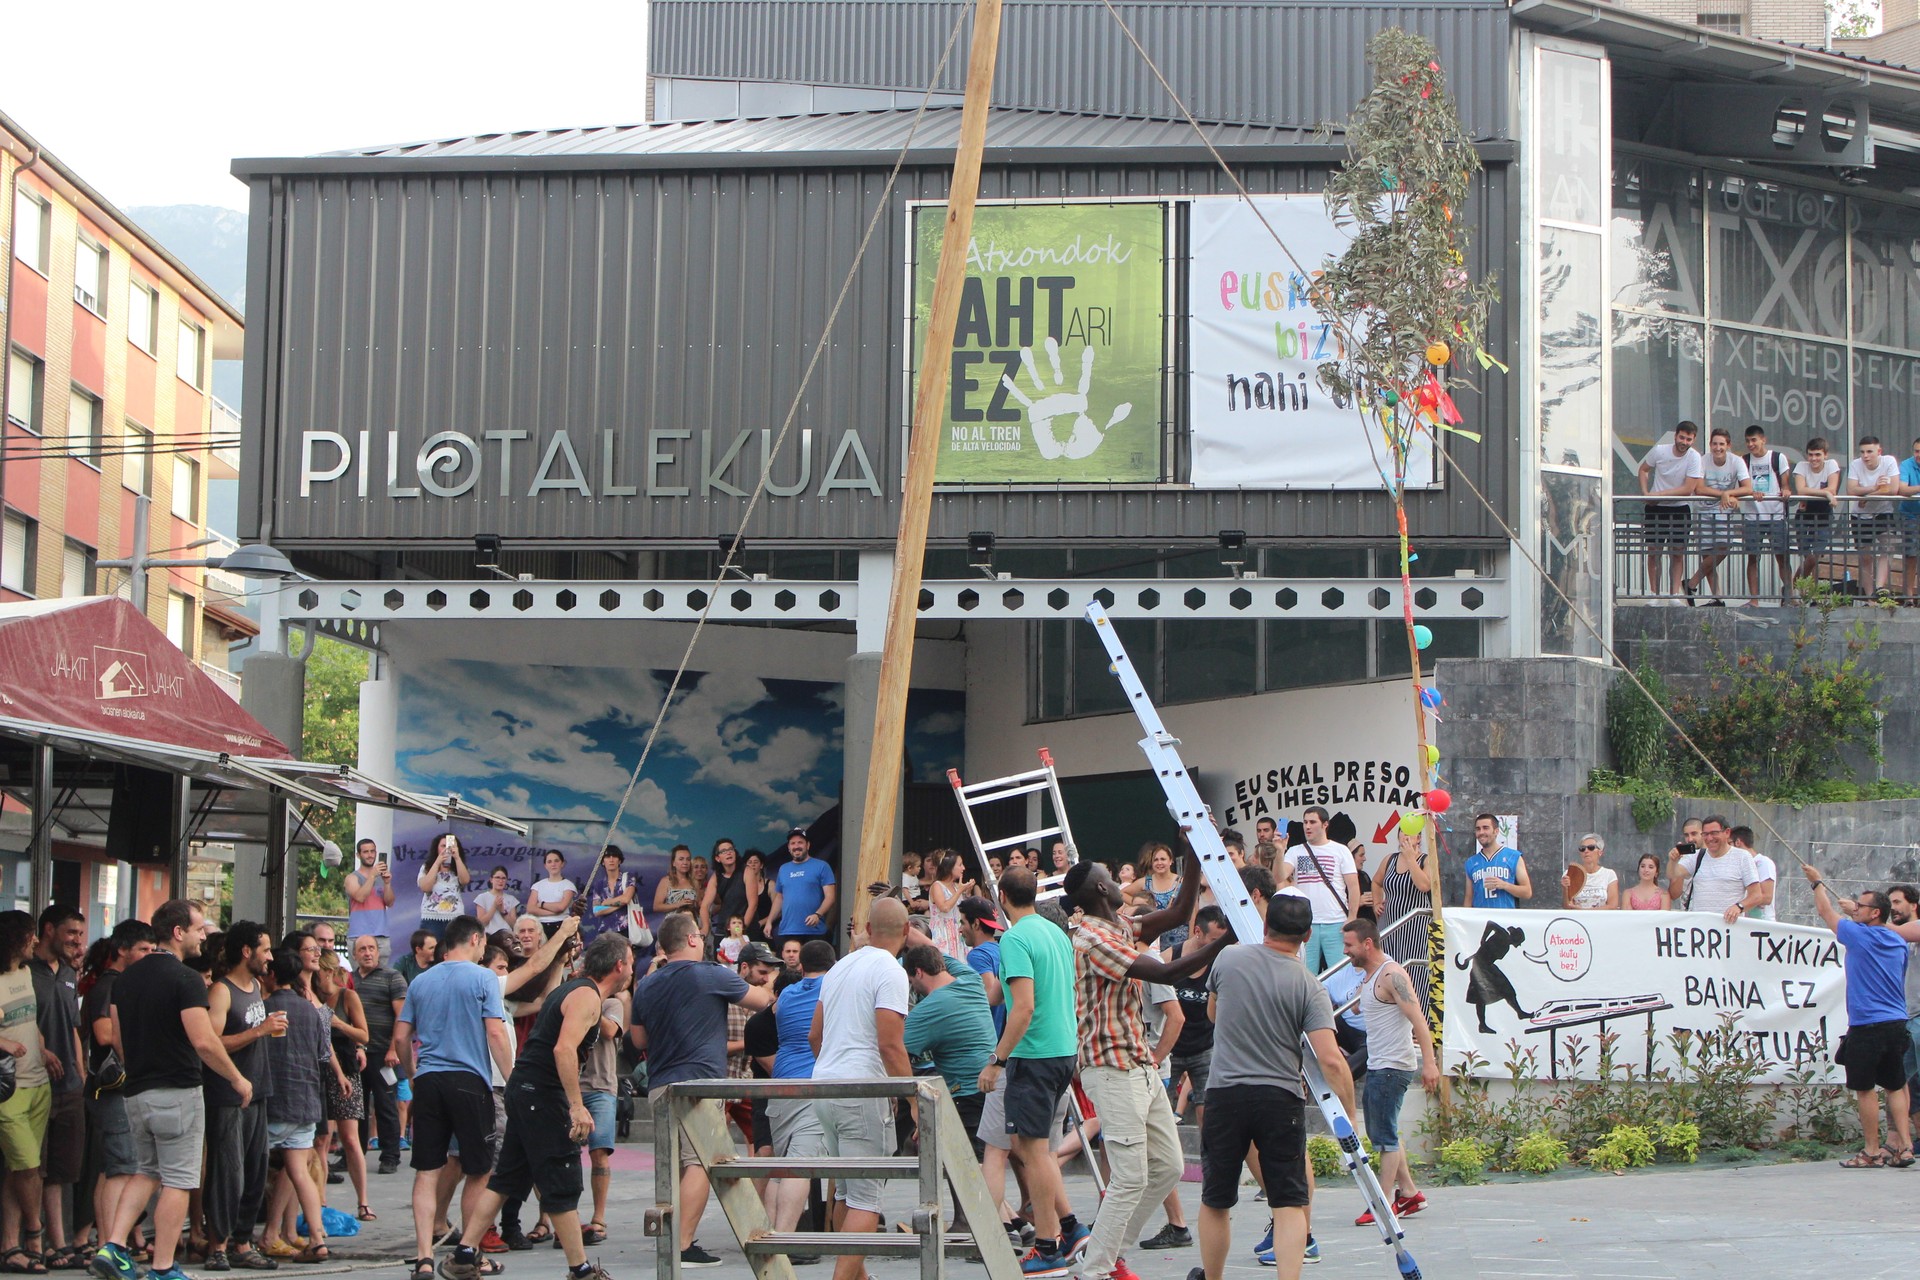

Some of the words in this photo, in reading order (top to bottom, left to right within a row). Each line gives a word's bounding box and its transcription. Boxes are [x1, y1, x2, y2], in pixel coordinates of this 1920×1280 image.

[951, 351, 1022, 422] EZ
[1226, 372, 1309, 412] nahi
[1711, 378, 1845, 431] ANBOTO
[952, 427, 968, 441] NO
[972, 427, 986, 441] AL
[990, 427, 1021, 441] TREN
[952, 442, 961, 451] DE
[963, 442, 979, 451] ALTA
[980, 442, 1021, 451] VELOCIDAD
[300, 429, 882, 499] PILOTALEKUA
[51, 651, 88, 681] JAI-KIT
[151, 672, 184, 699] JAI-KIT
[1235, 762, 1324, 803] EUSKAL
[1334, 761, 1410, 788] PRESO
[1225, 796, 1269, 827] ETA
[1277, 781, 1421, 810] IHESLARIAK
[1550, 934, 1585, 946] Atxondo
[1559, 949, 1578, 959] ikutu
[1560, 961, 1578, 972] bez!
[1781, 980, 1817, 1009] EZ
